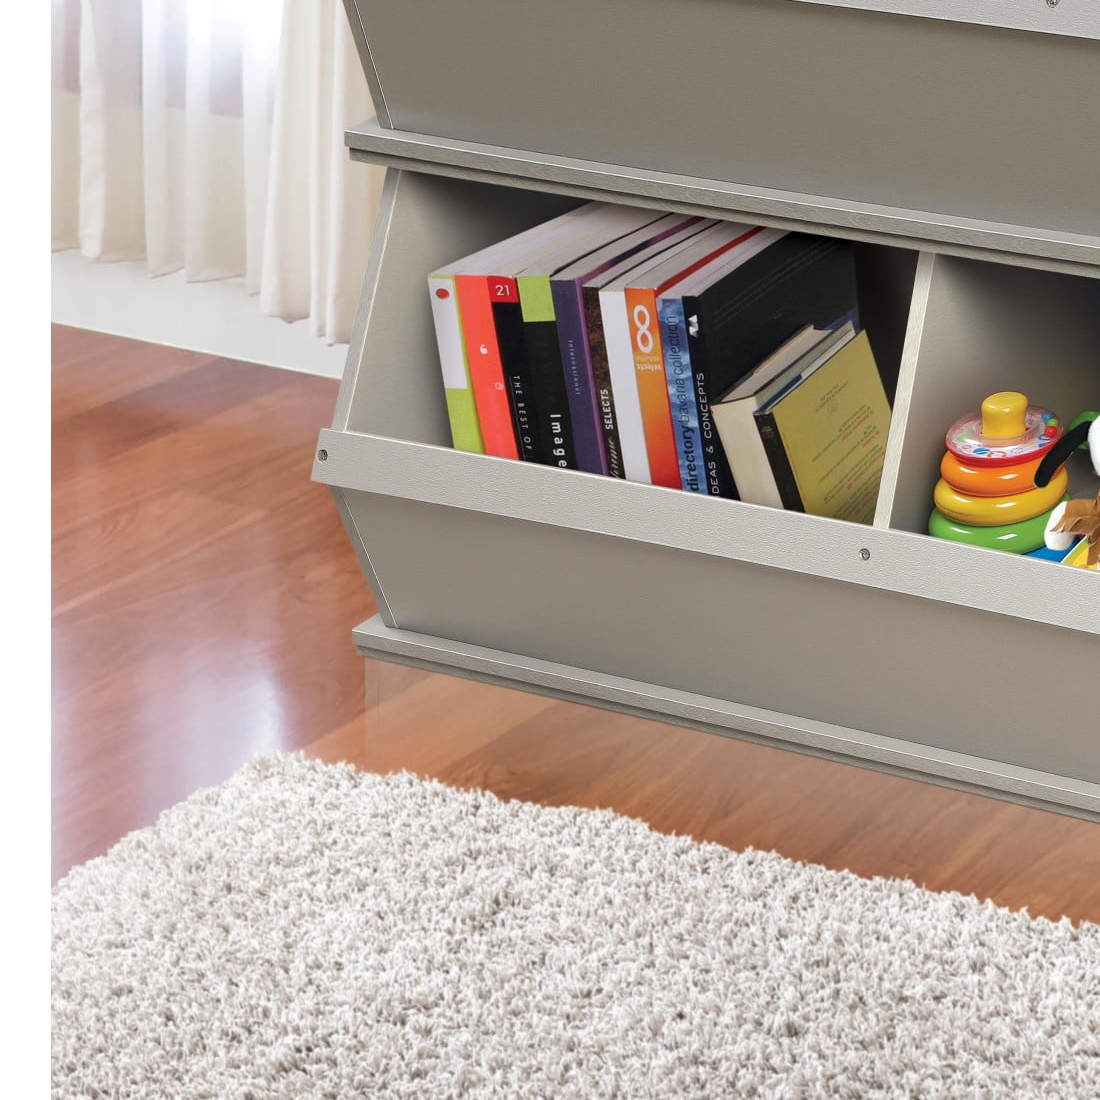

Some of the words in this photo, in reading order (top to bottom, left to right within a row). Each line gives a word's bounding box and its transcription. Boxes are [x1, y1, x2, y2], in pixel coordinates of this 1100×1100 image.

[495, 284, 510, 296] 21
[632, 304, 654, 354] 8
[666, 314, 686, 374] collection
[512, 375, 523, 395] THE
[567, 339, 581, 395] International
[517, 402, 529, 429] BEST
[599, 388, 614, 430] SELECTS
[676, 378, 691, 424] bavaria
[696, 372, 713, 439] CONCEPTS
[523, 436, 533, 450] OF
[549, 413, 568, 468] Image
[681, 426, 699, 492] directory
[705, 445, 714, 454] &
[708, 460, 720, 495] DEAS
